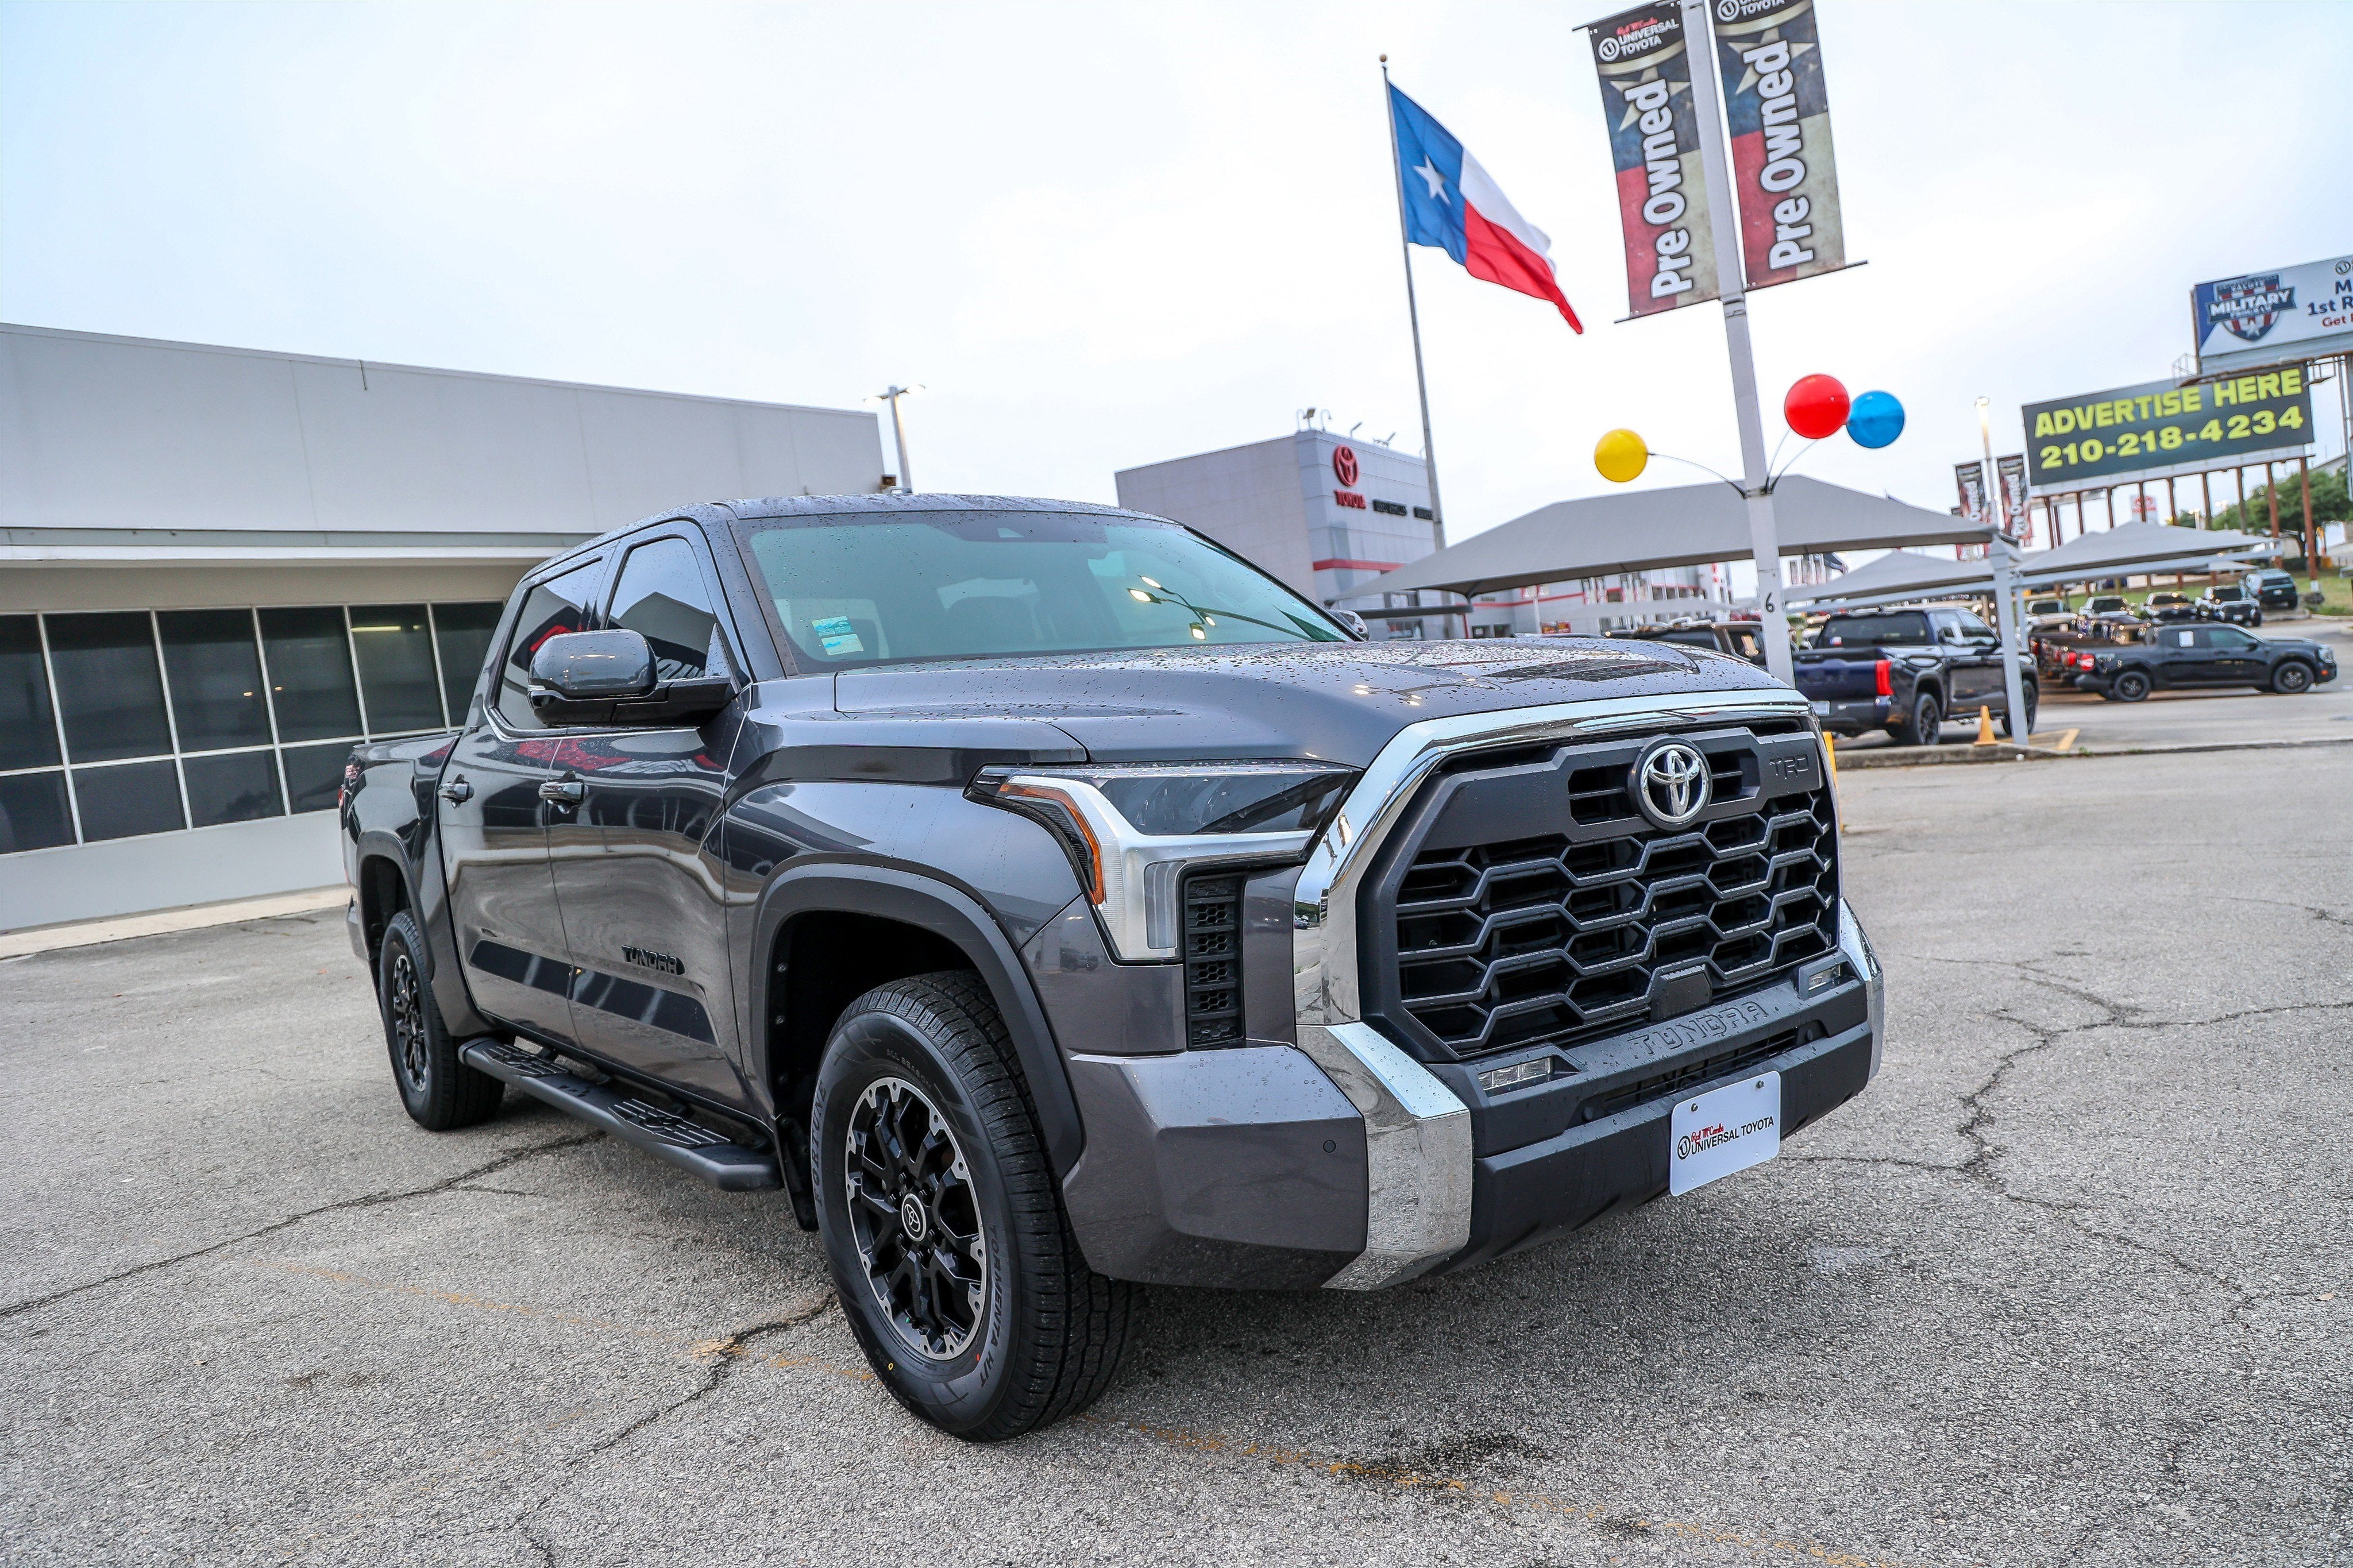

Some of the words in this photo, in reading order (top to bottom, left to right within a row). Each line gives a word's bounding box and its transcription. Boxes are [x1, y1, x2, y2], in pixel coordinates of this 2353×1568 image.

[1618, 18, 1679, 45] UNIVERSAL
[1620, 34, 1662, 56] TOYOTA
[1743, 40, 1805, 192] Owned
[1624, 79, 1685, 225] Owned
[1769, 196, 1813, 270] Pre
[1651, 229, 1692, 299] Pre
[2210, 289, 2291, 315] MILITARY
[2307, 299, 2336, 316] 1st
[2322, 315, 2346, 327] Get
[2034, 387, 2202, 438] ADVERTISE
[2212, 368, 2302, 408] HERE
[2039, 405, 2304, 470] 210-218-4234
[1765, 591, 1776, 613] 6
[1769, 754, 1810, 780] TRD
[621, 945, 685, 975] TUNDRA
[1629, 1001, 1768, 1056] TUNDRA
[812, 1080, 826, 1207] FORTUNE
[1691, 1128, 1740, 1154] UNIVERSAL
[1741, 1116, 1774, 1136] TOYOTA
[989, 1224, 1002, 1347] TORMENTA
